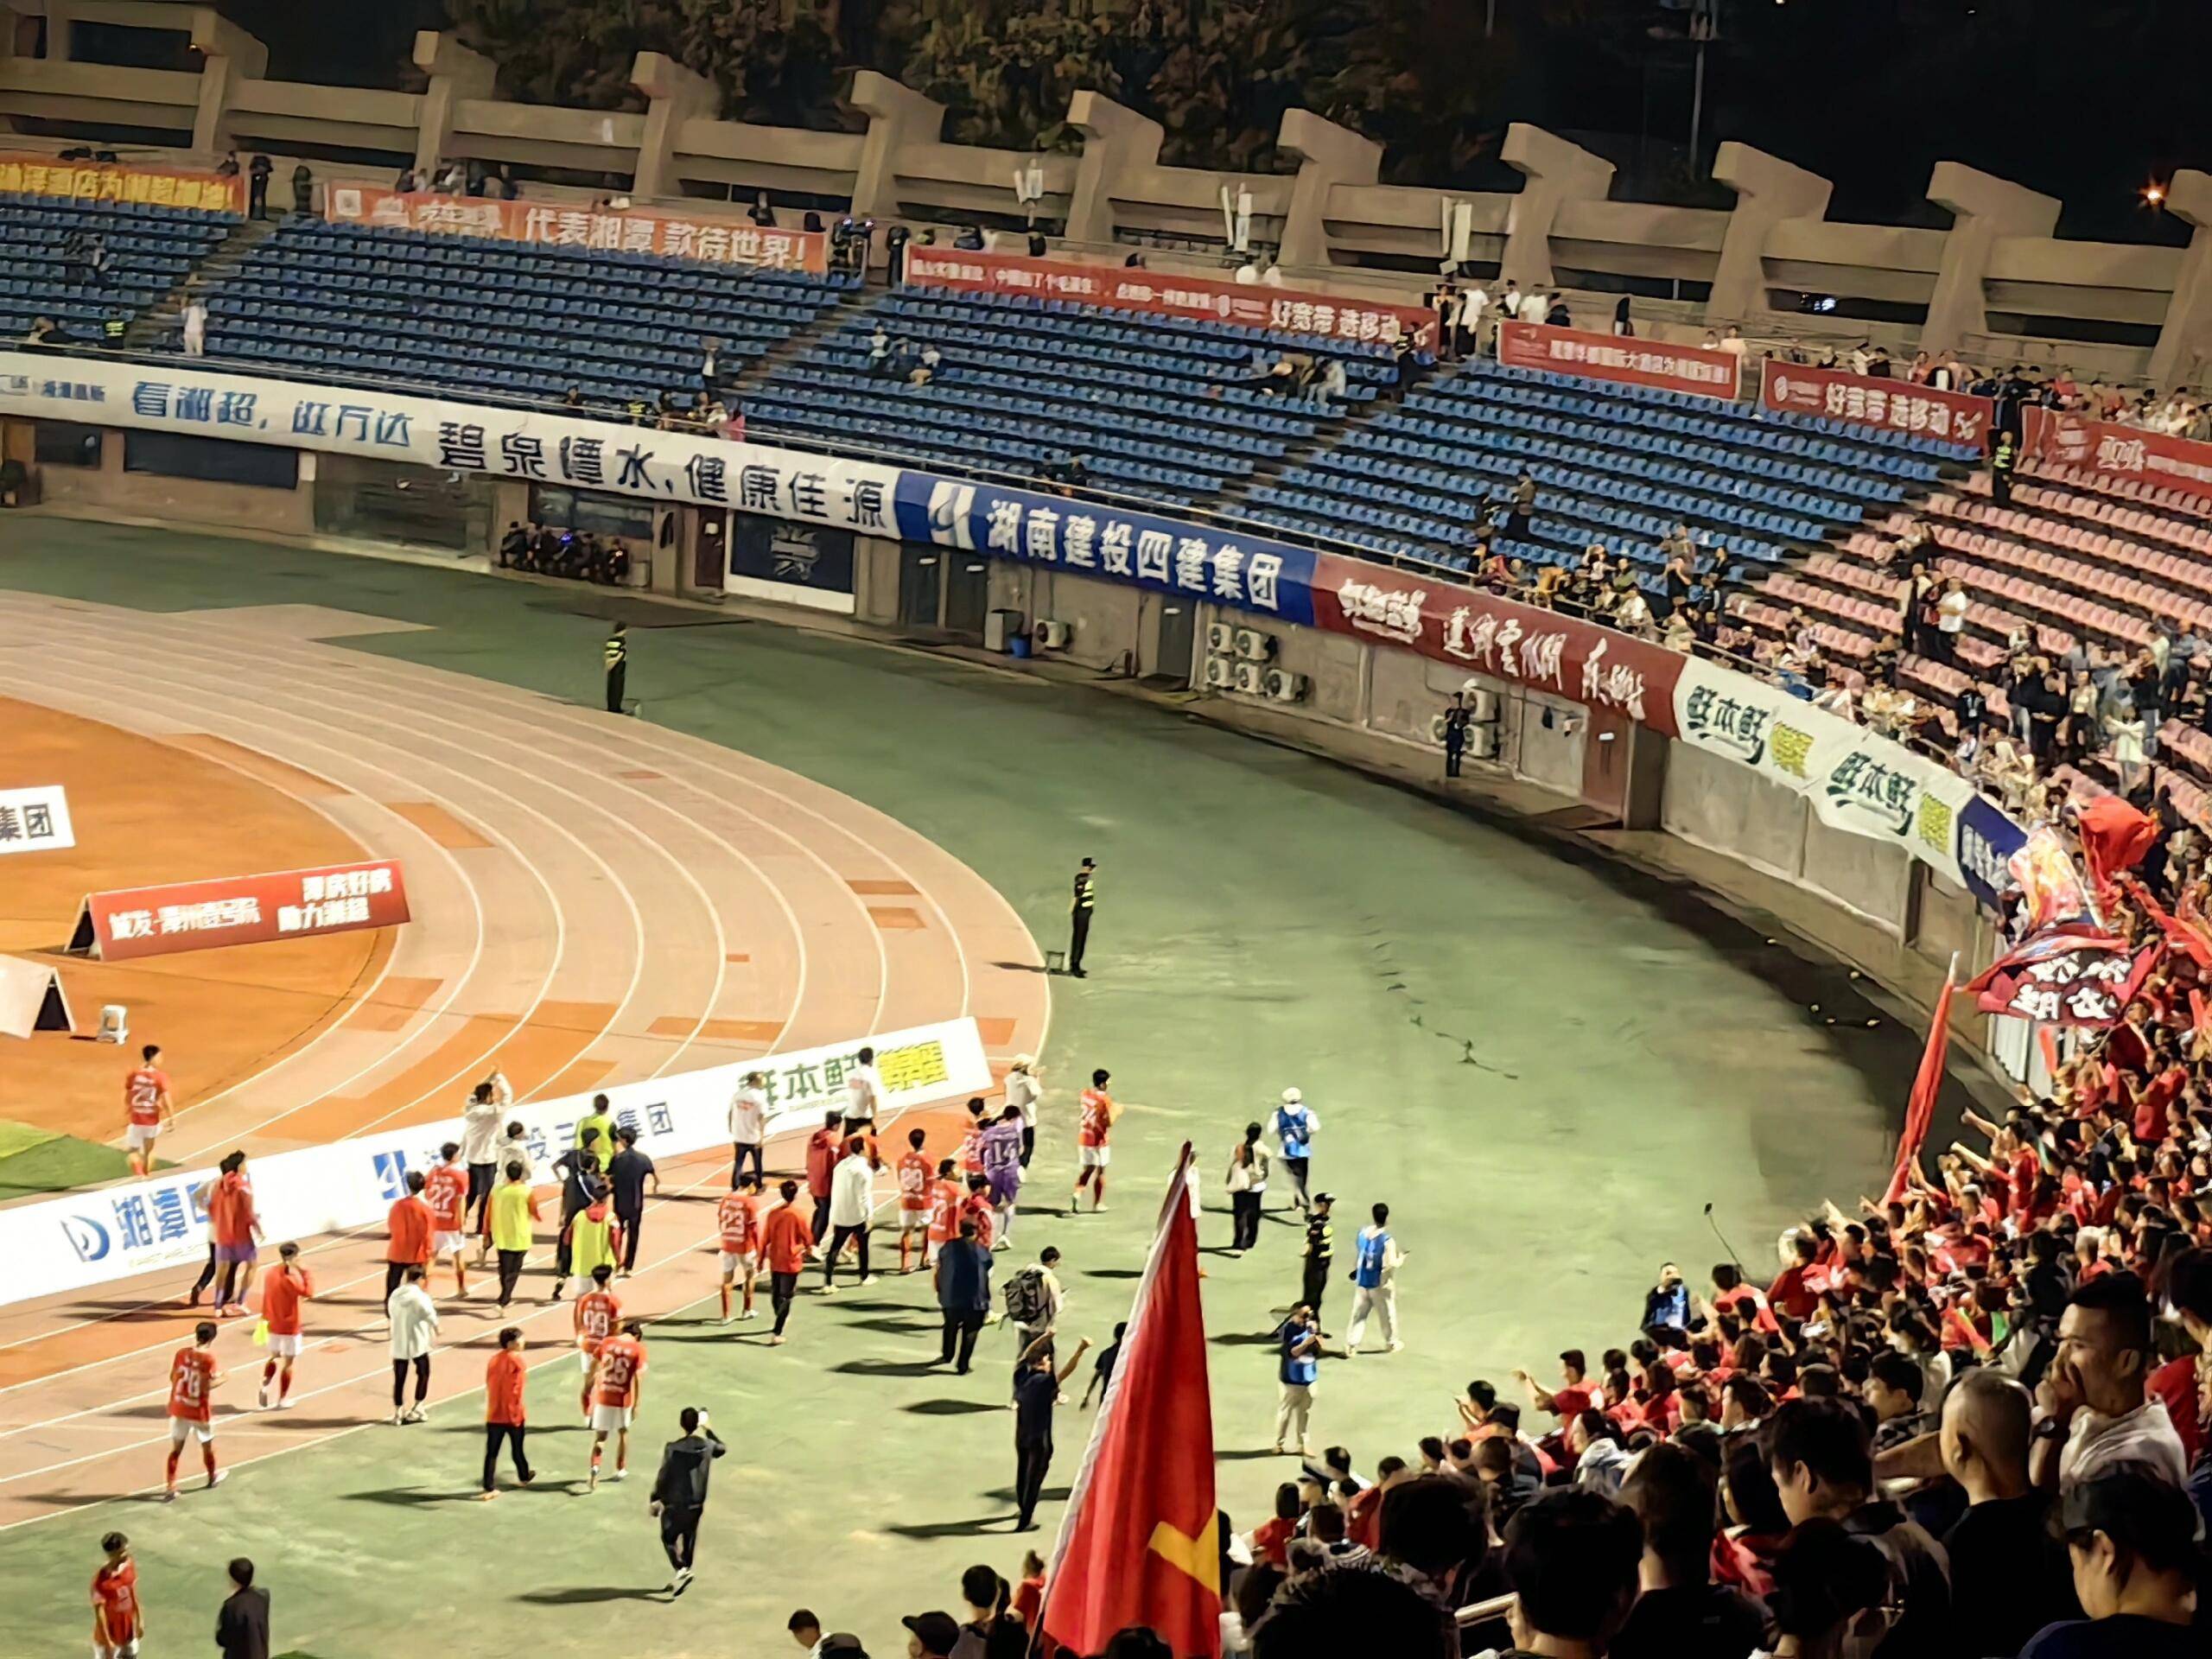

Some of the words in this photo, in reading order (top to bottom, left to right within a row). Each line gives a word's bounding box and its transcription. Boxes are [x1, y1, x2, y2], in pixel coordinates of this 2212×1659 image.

[986, 499, 1284, 610] 湖南建投四建集团
